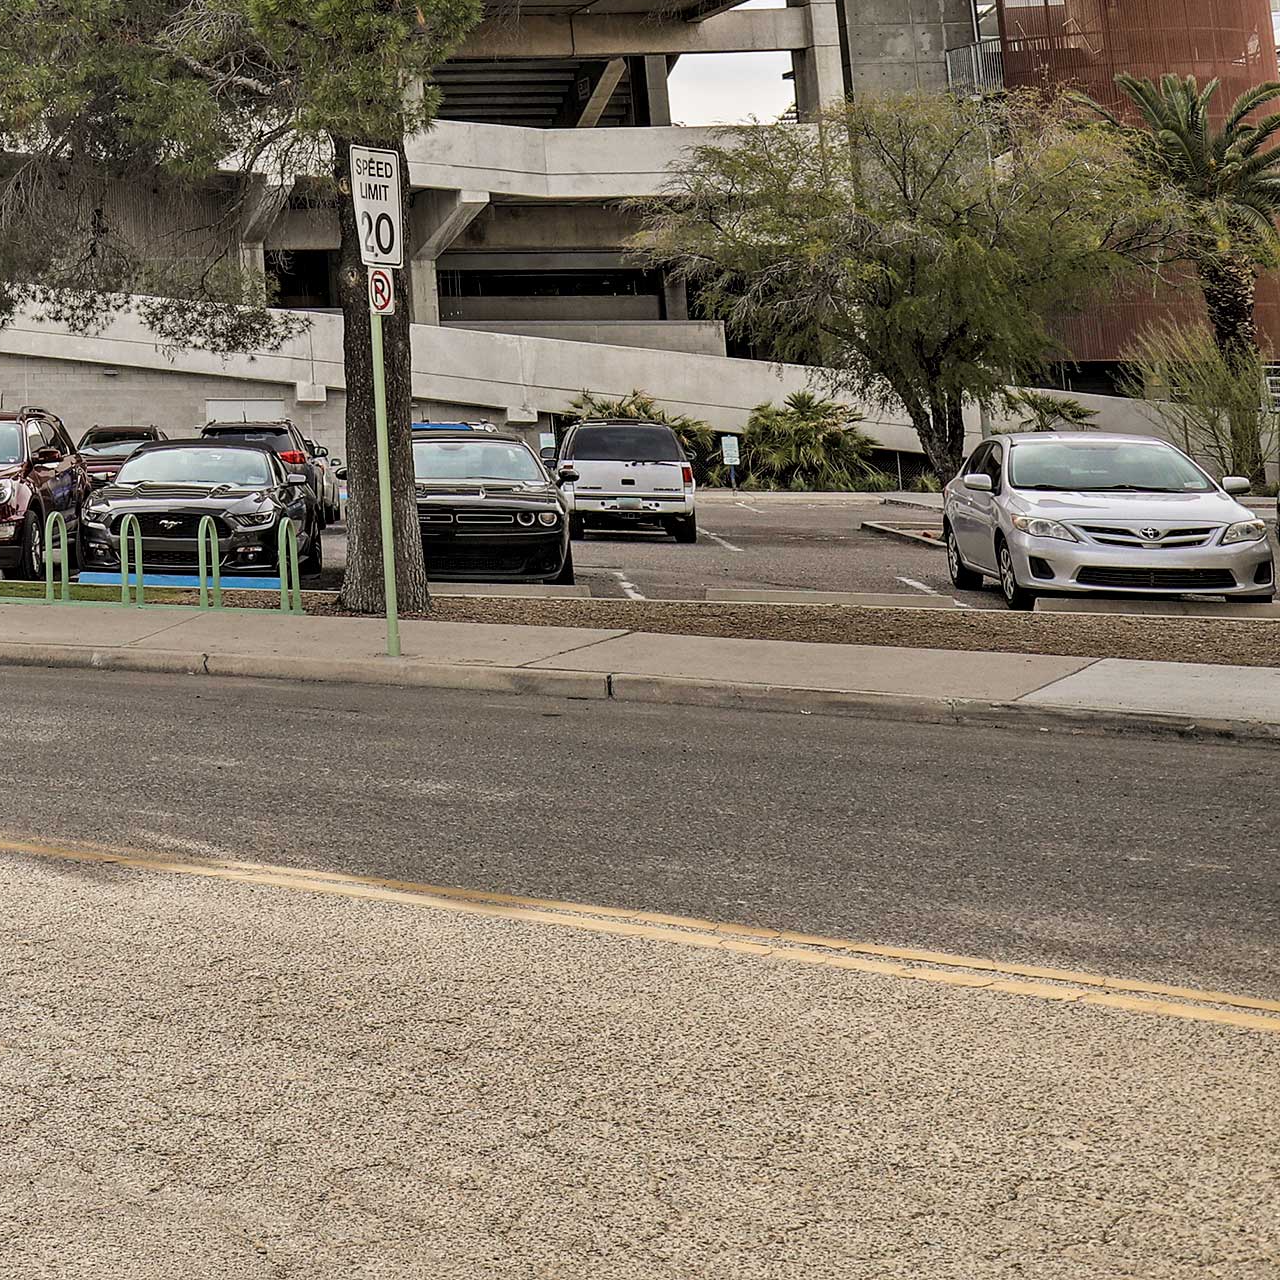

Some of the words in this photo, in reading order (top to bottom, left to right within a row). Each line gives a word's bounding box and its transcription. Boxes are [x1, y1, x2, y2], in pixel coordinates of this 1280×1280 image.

[355, 157, 393, 179] SPEED
[360, 182, 389, 201] LIMIT
[361, 210, 395, 255] 20
